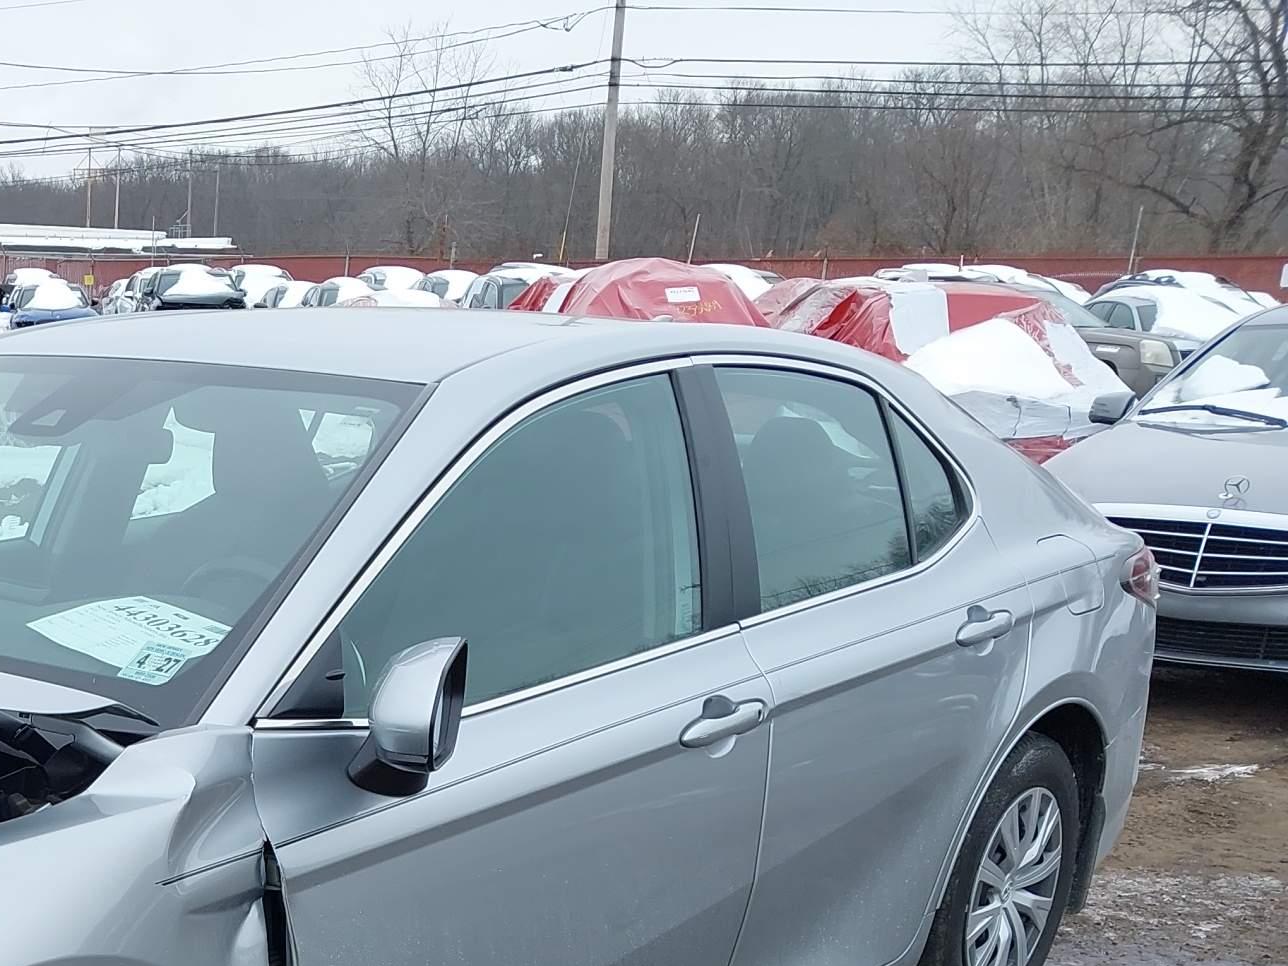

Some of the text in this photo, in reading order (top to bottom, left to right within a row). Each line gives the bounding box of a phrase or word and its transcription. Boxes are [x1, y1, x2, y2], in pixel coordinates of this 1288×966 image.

[114, 605, 219, 647] 44303628
[137, 653, 182, 674] 4 27
